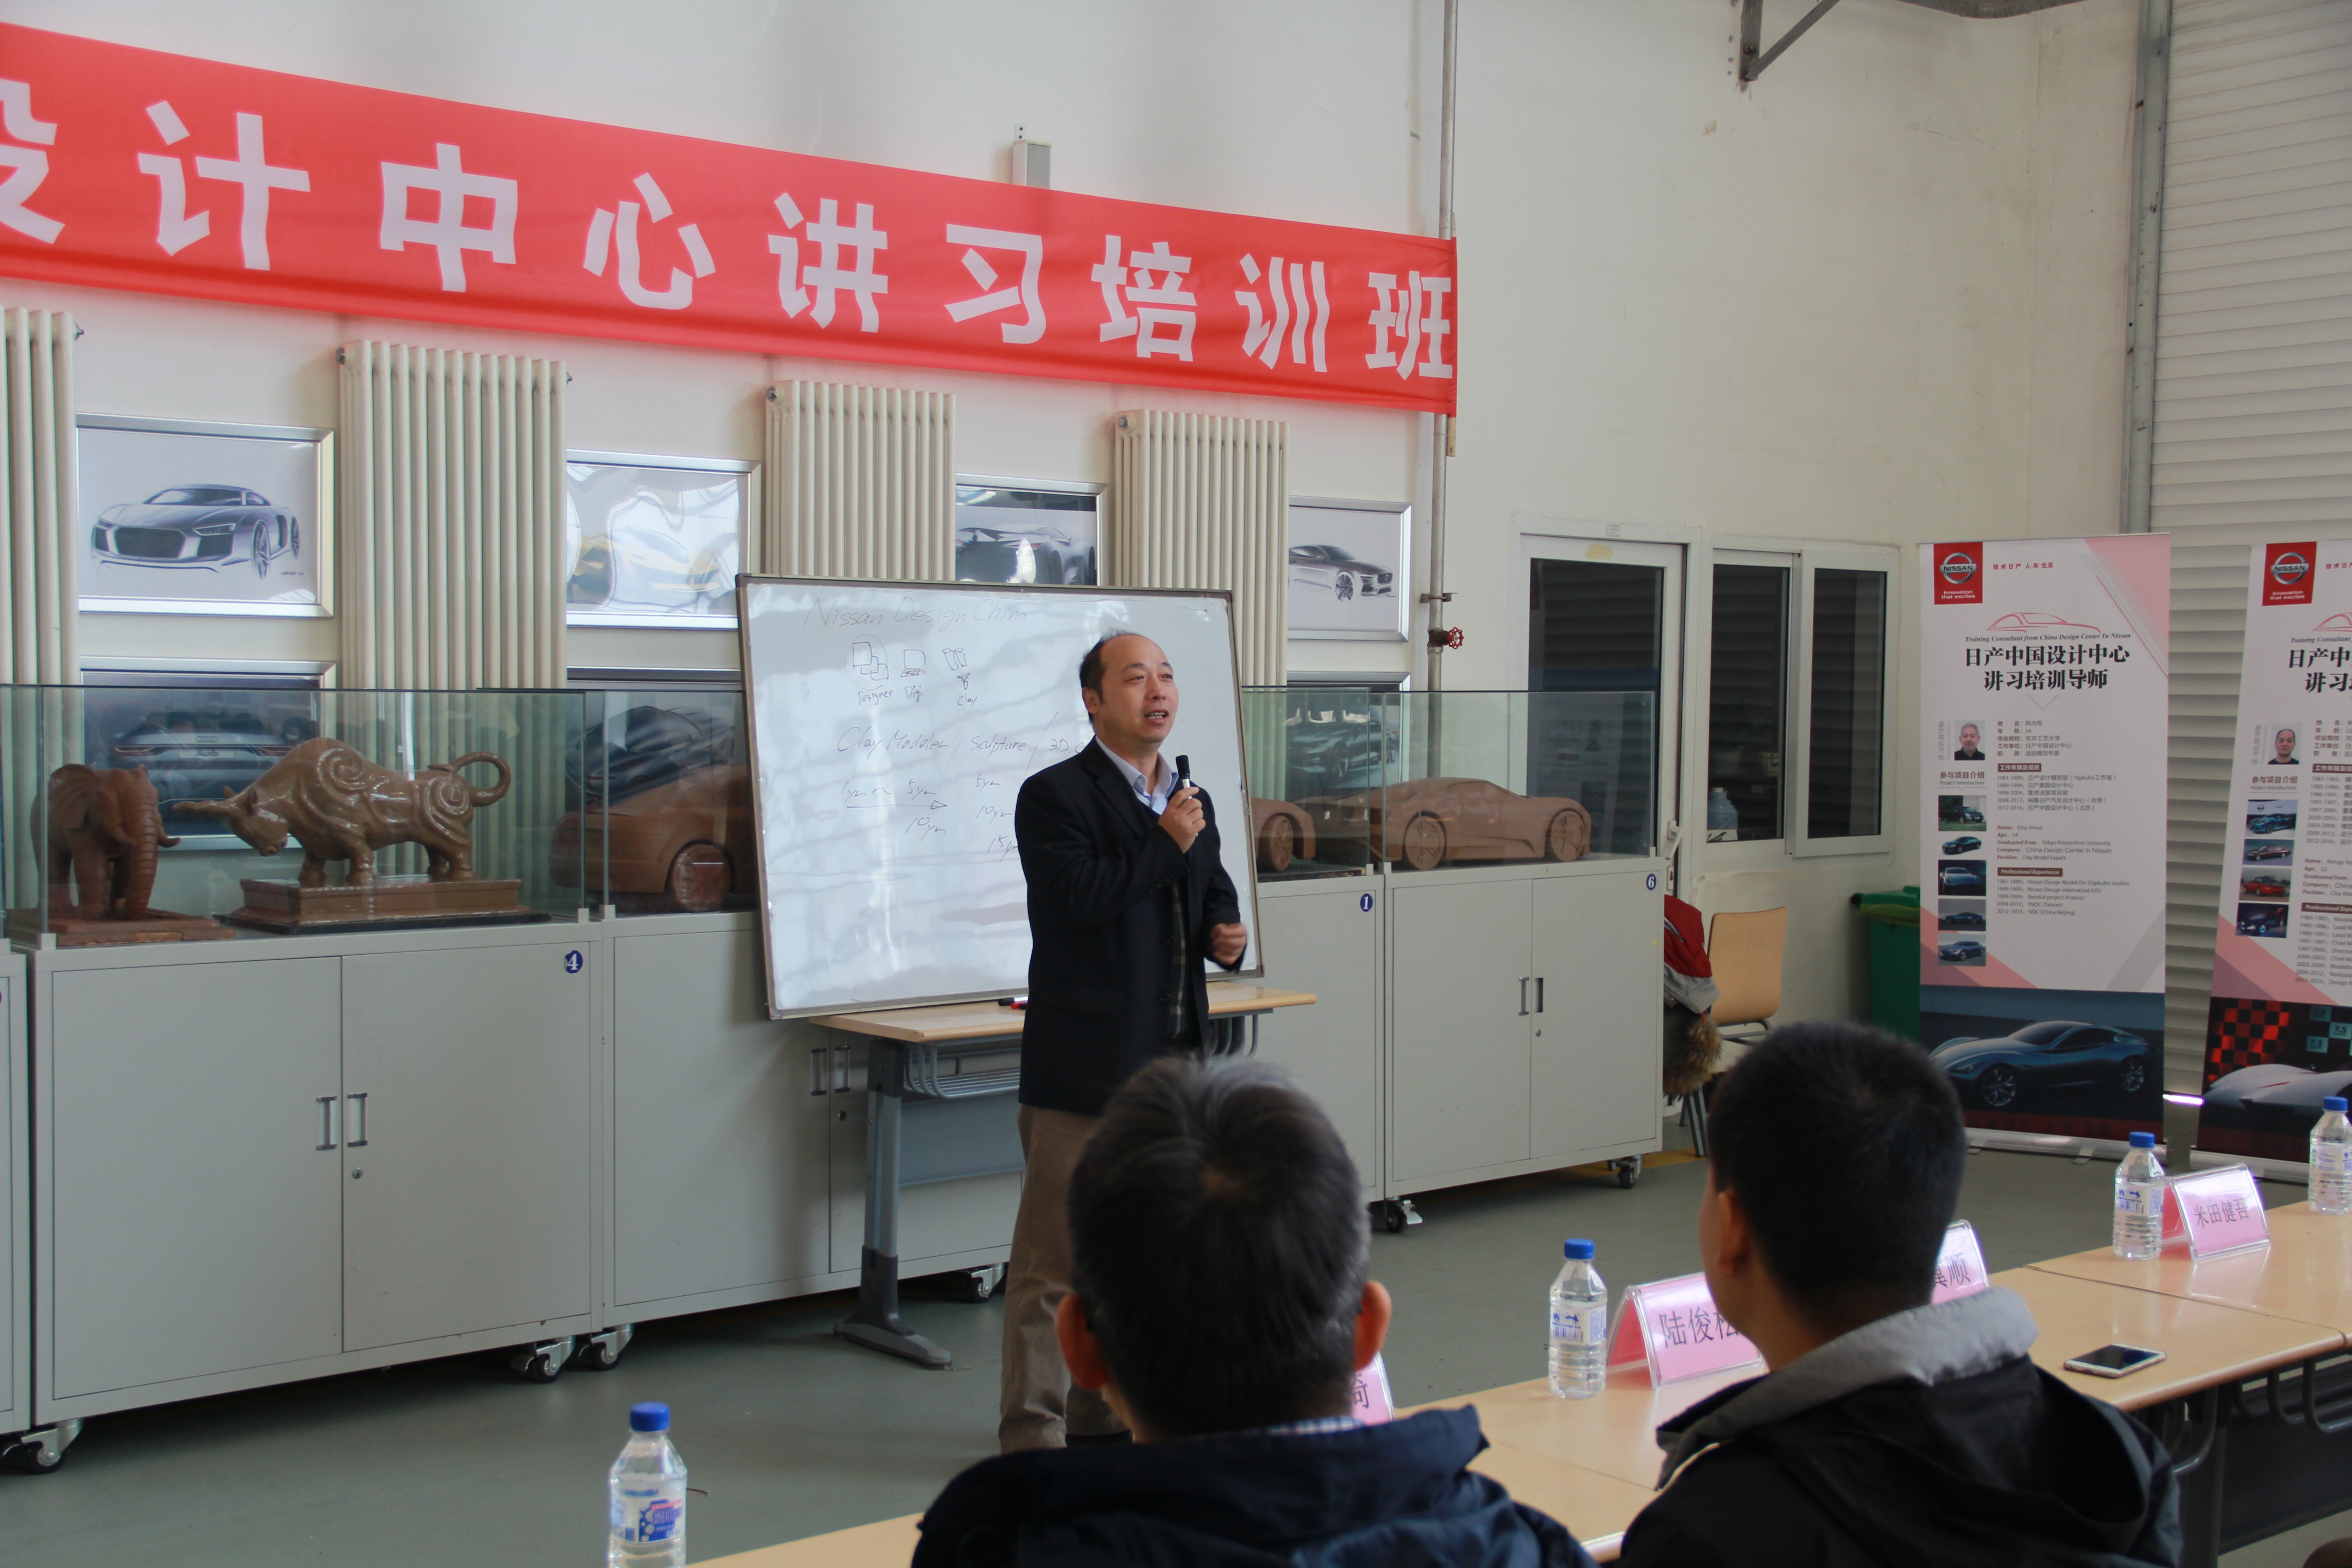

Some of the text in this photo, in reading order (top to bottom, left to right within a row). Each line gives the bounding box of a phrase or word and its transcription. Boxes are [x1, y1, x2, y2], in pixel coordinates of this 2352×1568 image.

[803, 597, 1027, 632] Nissan Design China
[1965, 644, 2130, 666] 日产中国设计中心
[1984, 669, 2108, 691] 讲习培训导师
[2305, 672, 2352, 693] 讲习
[838, 726, 882, 759] Clay
[887, 730, 949, 750] Modeler
[1647, 876, 1655, 888] 6
[1363, 896, 1369, 909] 1
[568, 954, 579, 970] 4
[2193, 1198, 2249, 1227] 米田健吾
